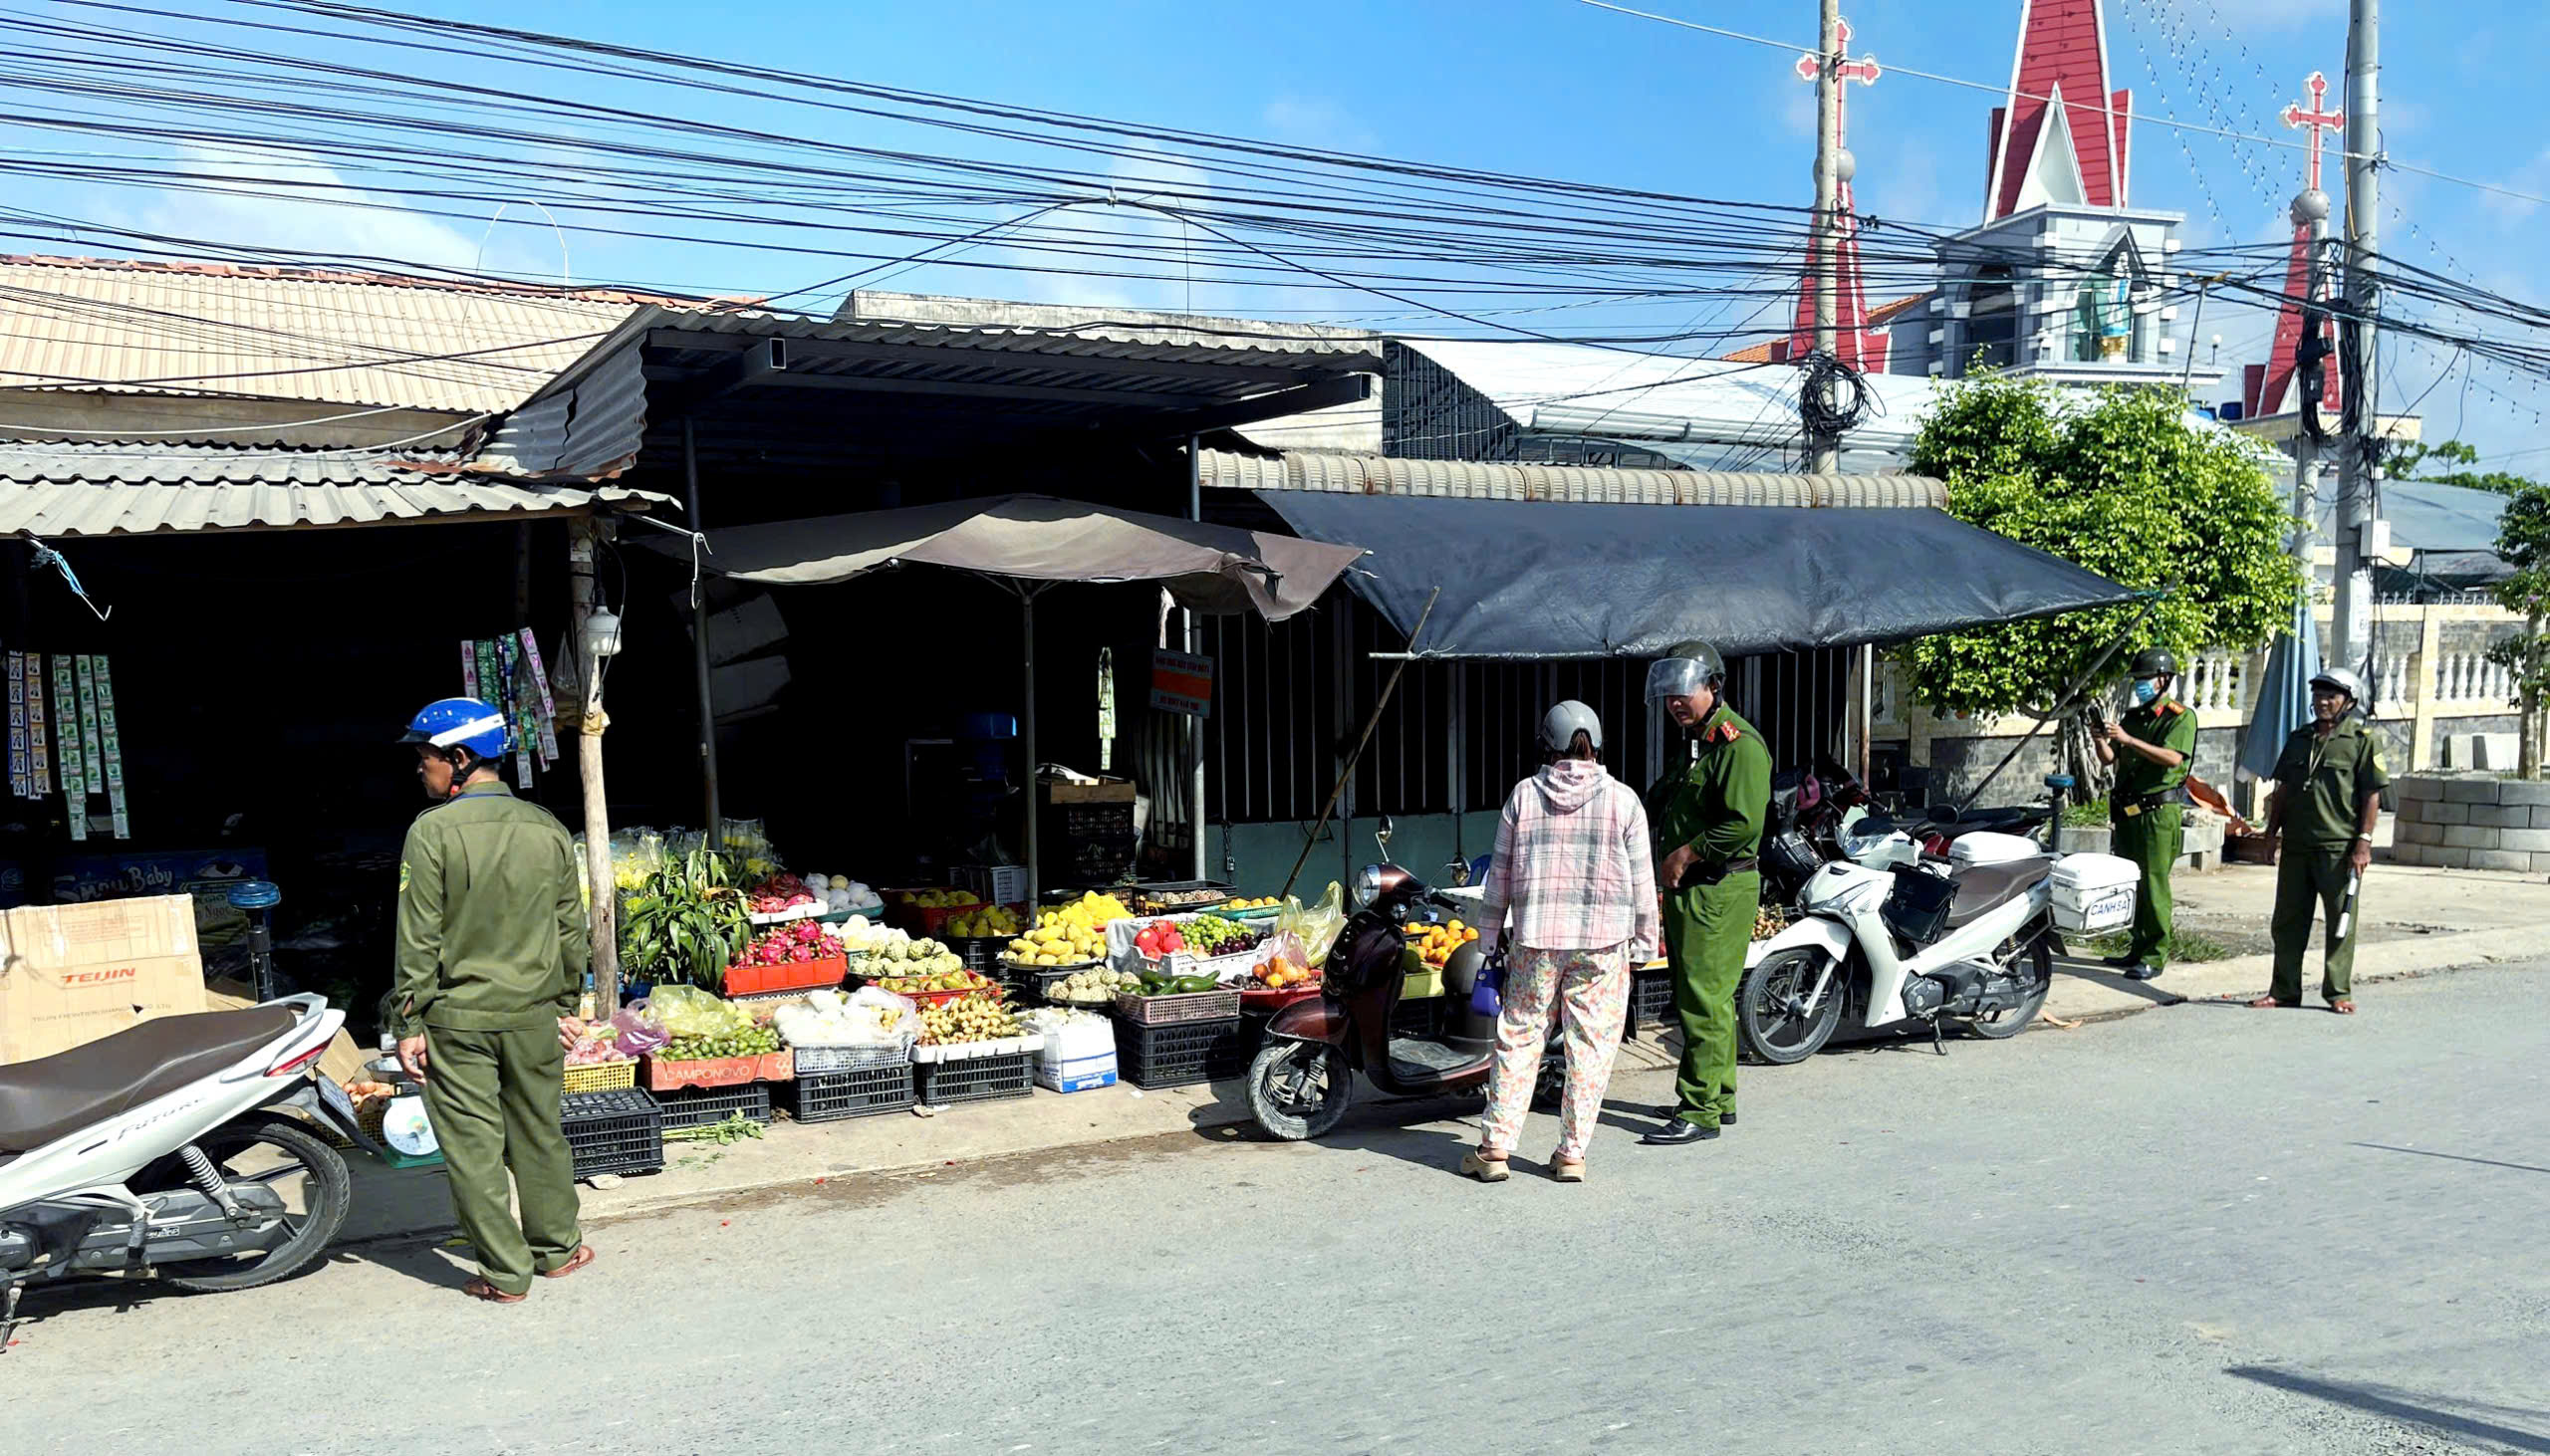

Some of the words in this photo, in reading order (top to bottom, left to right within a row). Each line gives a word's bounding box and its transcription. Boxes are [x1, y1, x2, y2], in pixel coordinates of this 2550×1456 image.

[128, 864, 173, 893] Baby
[61, 967, 136, 984] TEIJIN
[664, 1066, 750, 1081] CAMPONOVO
